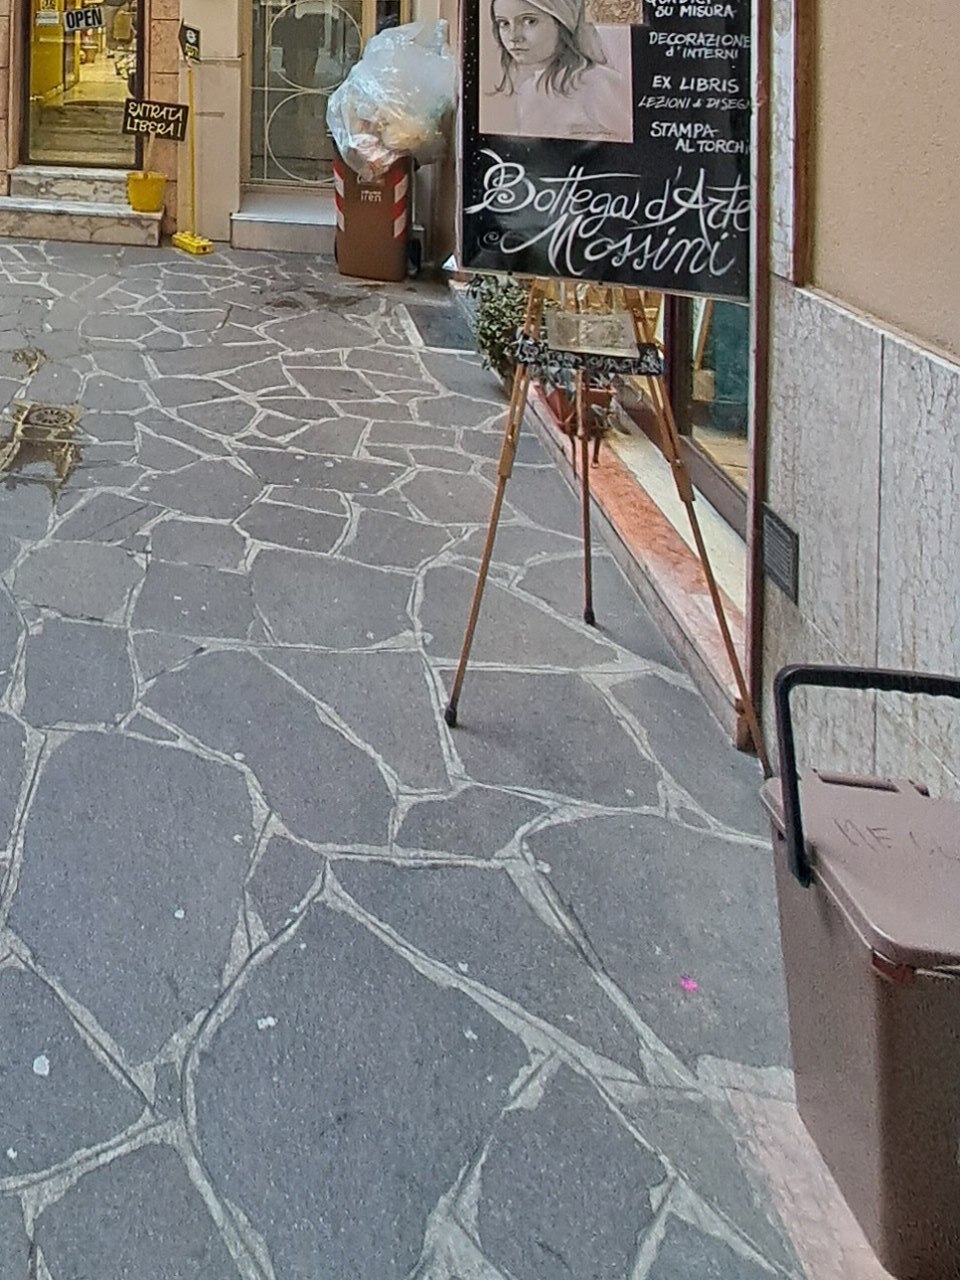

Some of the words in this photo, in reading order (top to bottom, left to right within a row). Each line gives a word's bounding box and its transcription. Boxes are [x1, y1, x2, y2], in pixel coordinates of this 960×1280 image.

[65, 8, 103, 29] OPEN
[654, 5, 674, 18] SU
[679, 4, 738, 19] MISURA
[652, 75, 672, 90] EX
[679, 76, 740, 94] LIBRIS
[638, 96, 692, 109] LEZIONI
[650, 121, 719, 139] STAMPA
[674, 138, 696, 154] AL
[464, 149, 641, 239] Bottega
